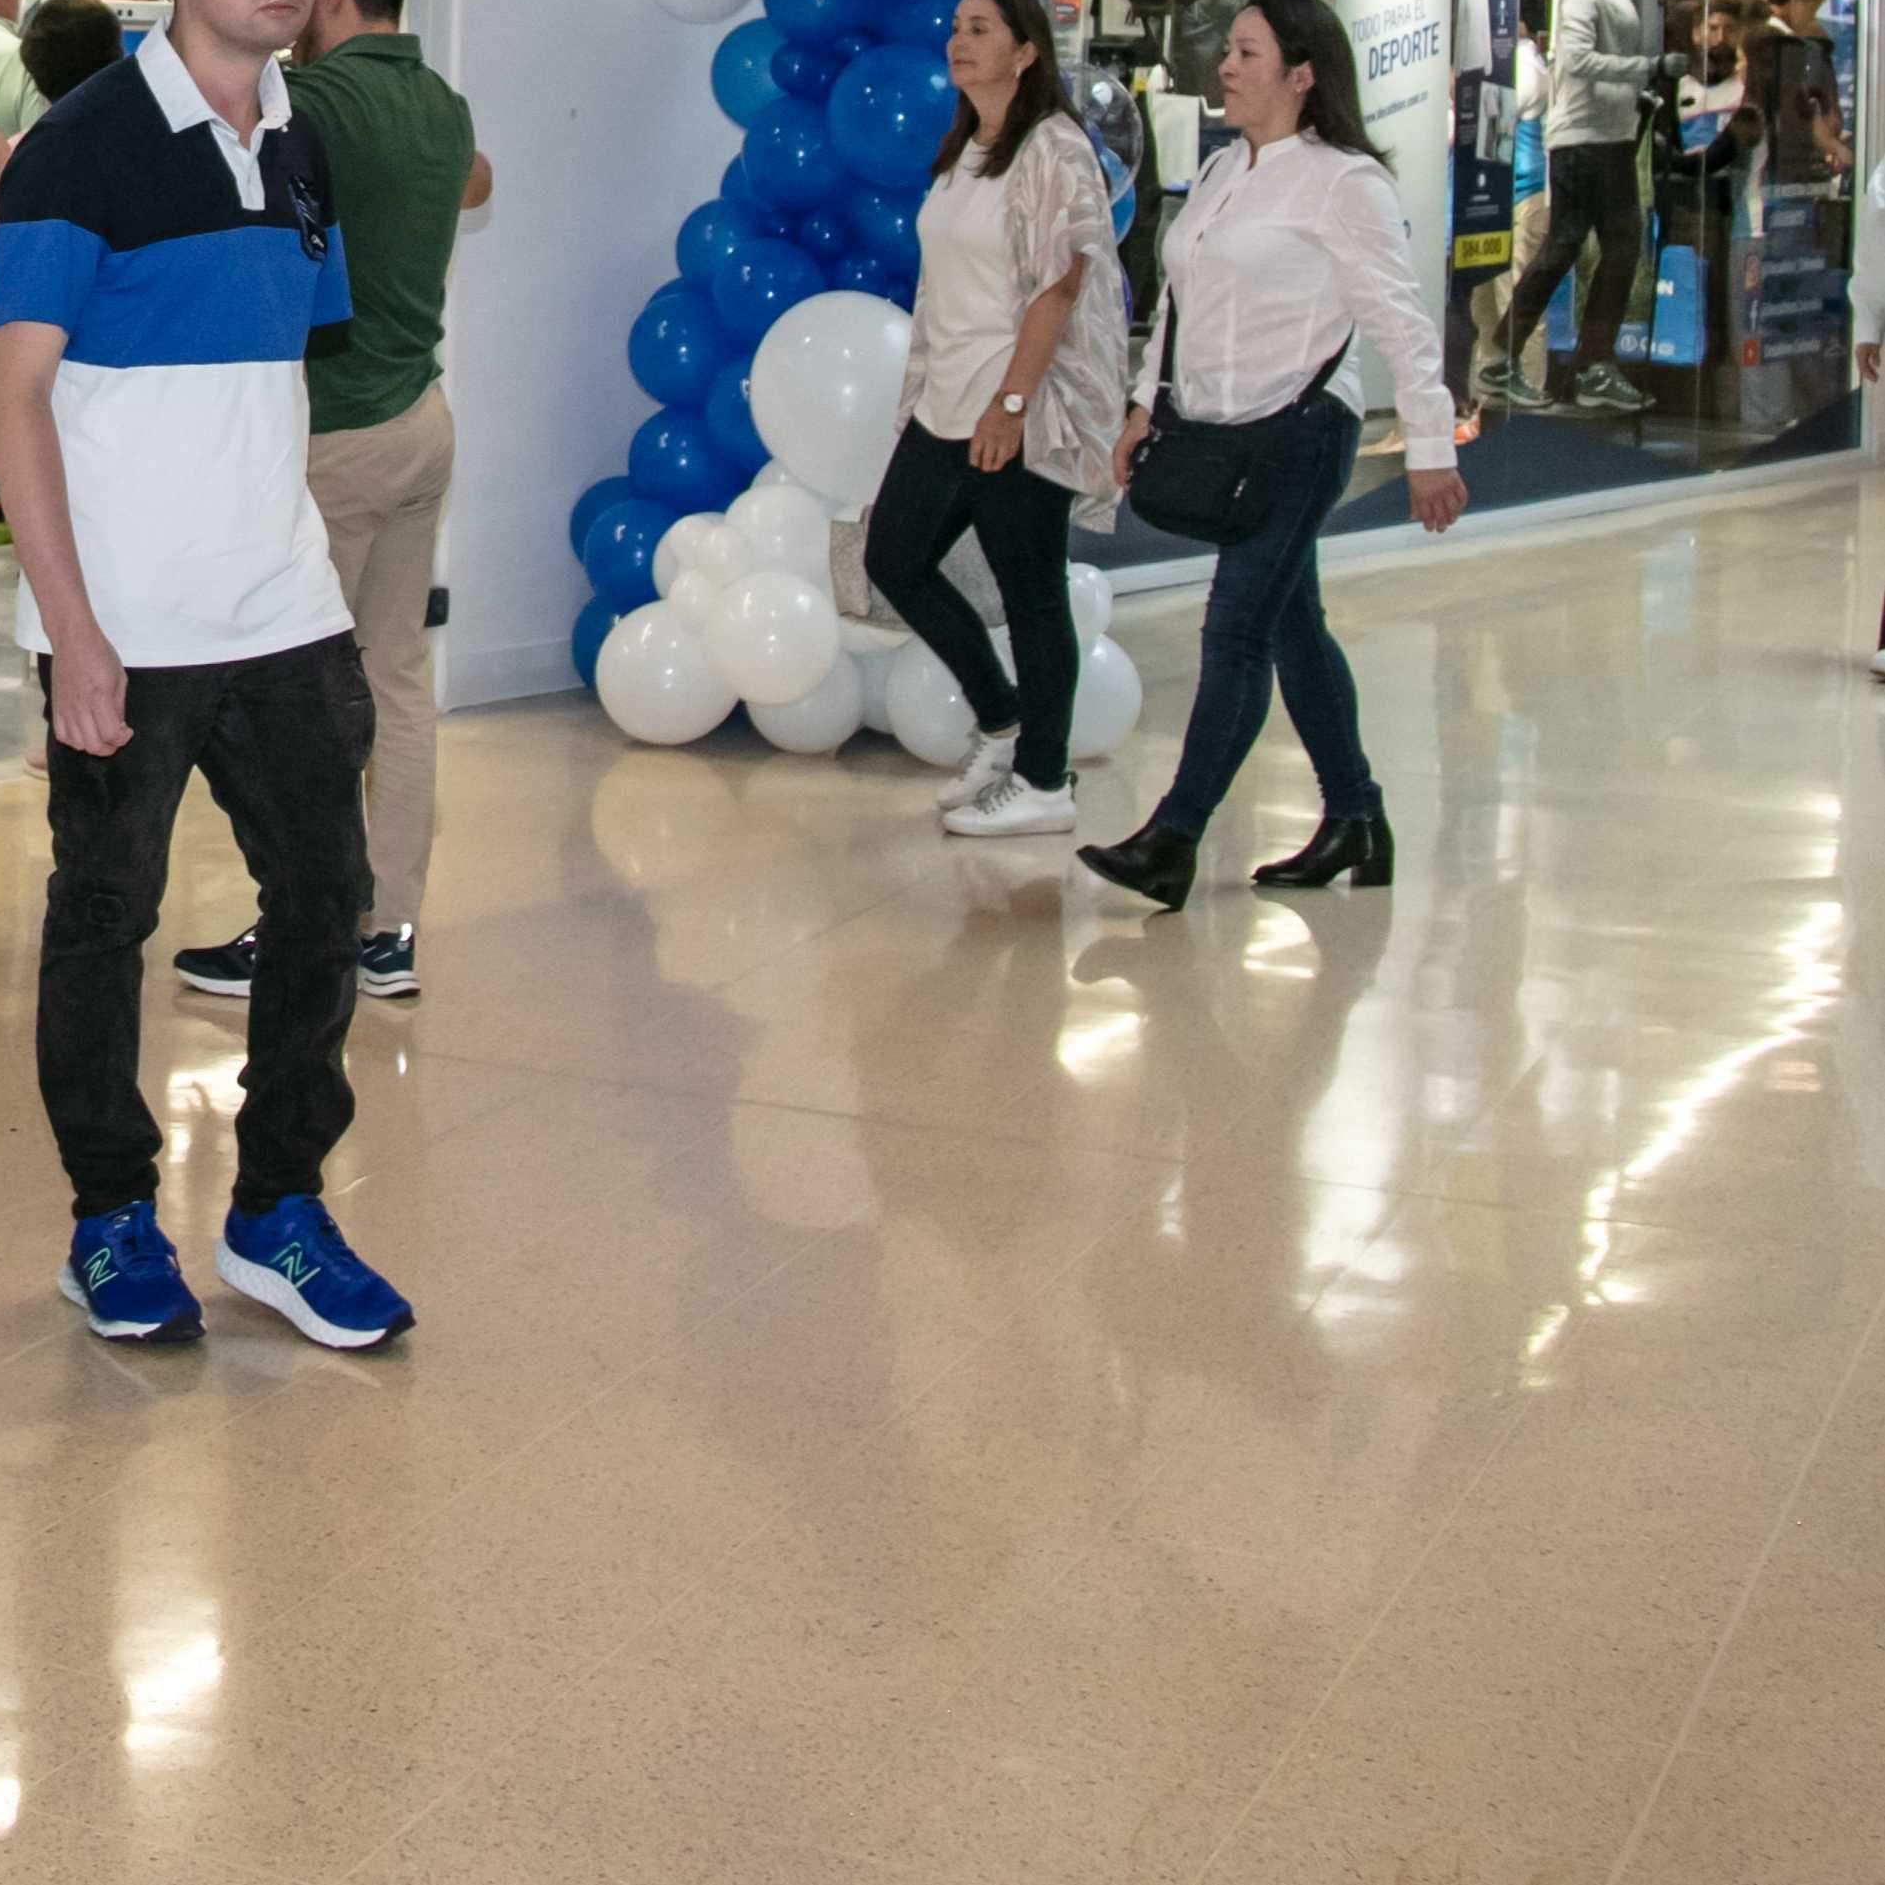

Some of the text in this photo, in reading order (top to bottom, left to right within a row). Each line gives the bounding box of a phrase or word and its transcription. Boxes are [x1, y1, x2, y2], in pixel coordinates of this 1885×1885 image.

[1351, 12, 1381, 45] TODO
[1383, 3, 1412, 33] PARA
[1368, 20, 1441, 81] DEPORTE
